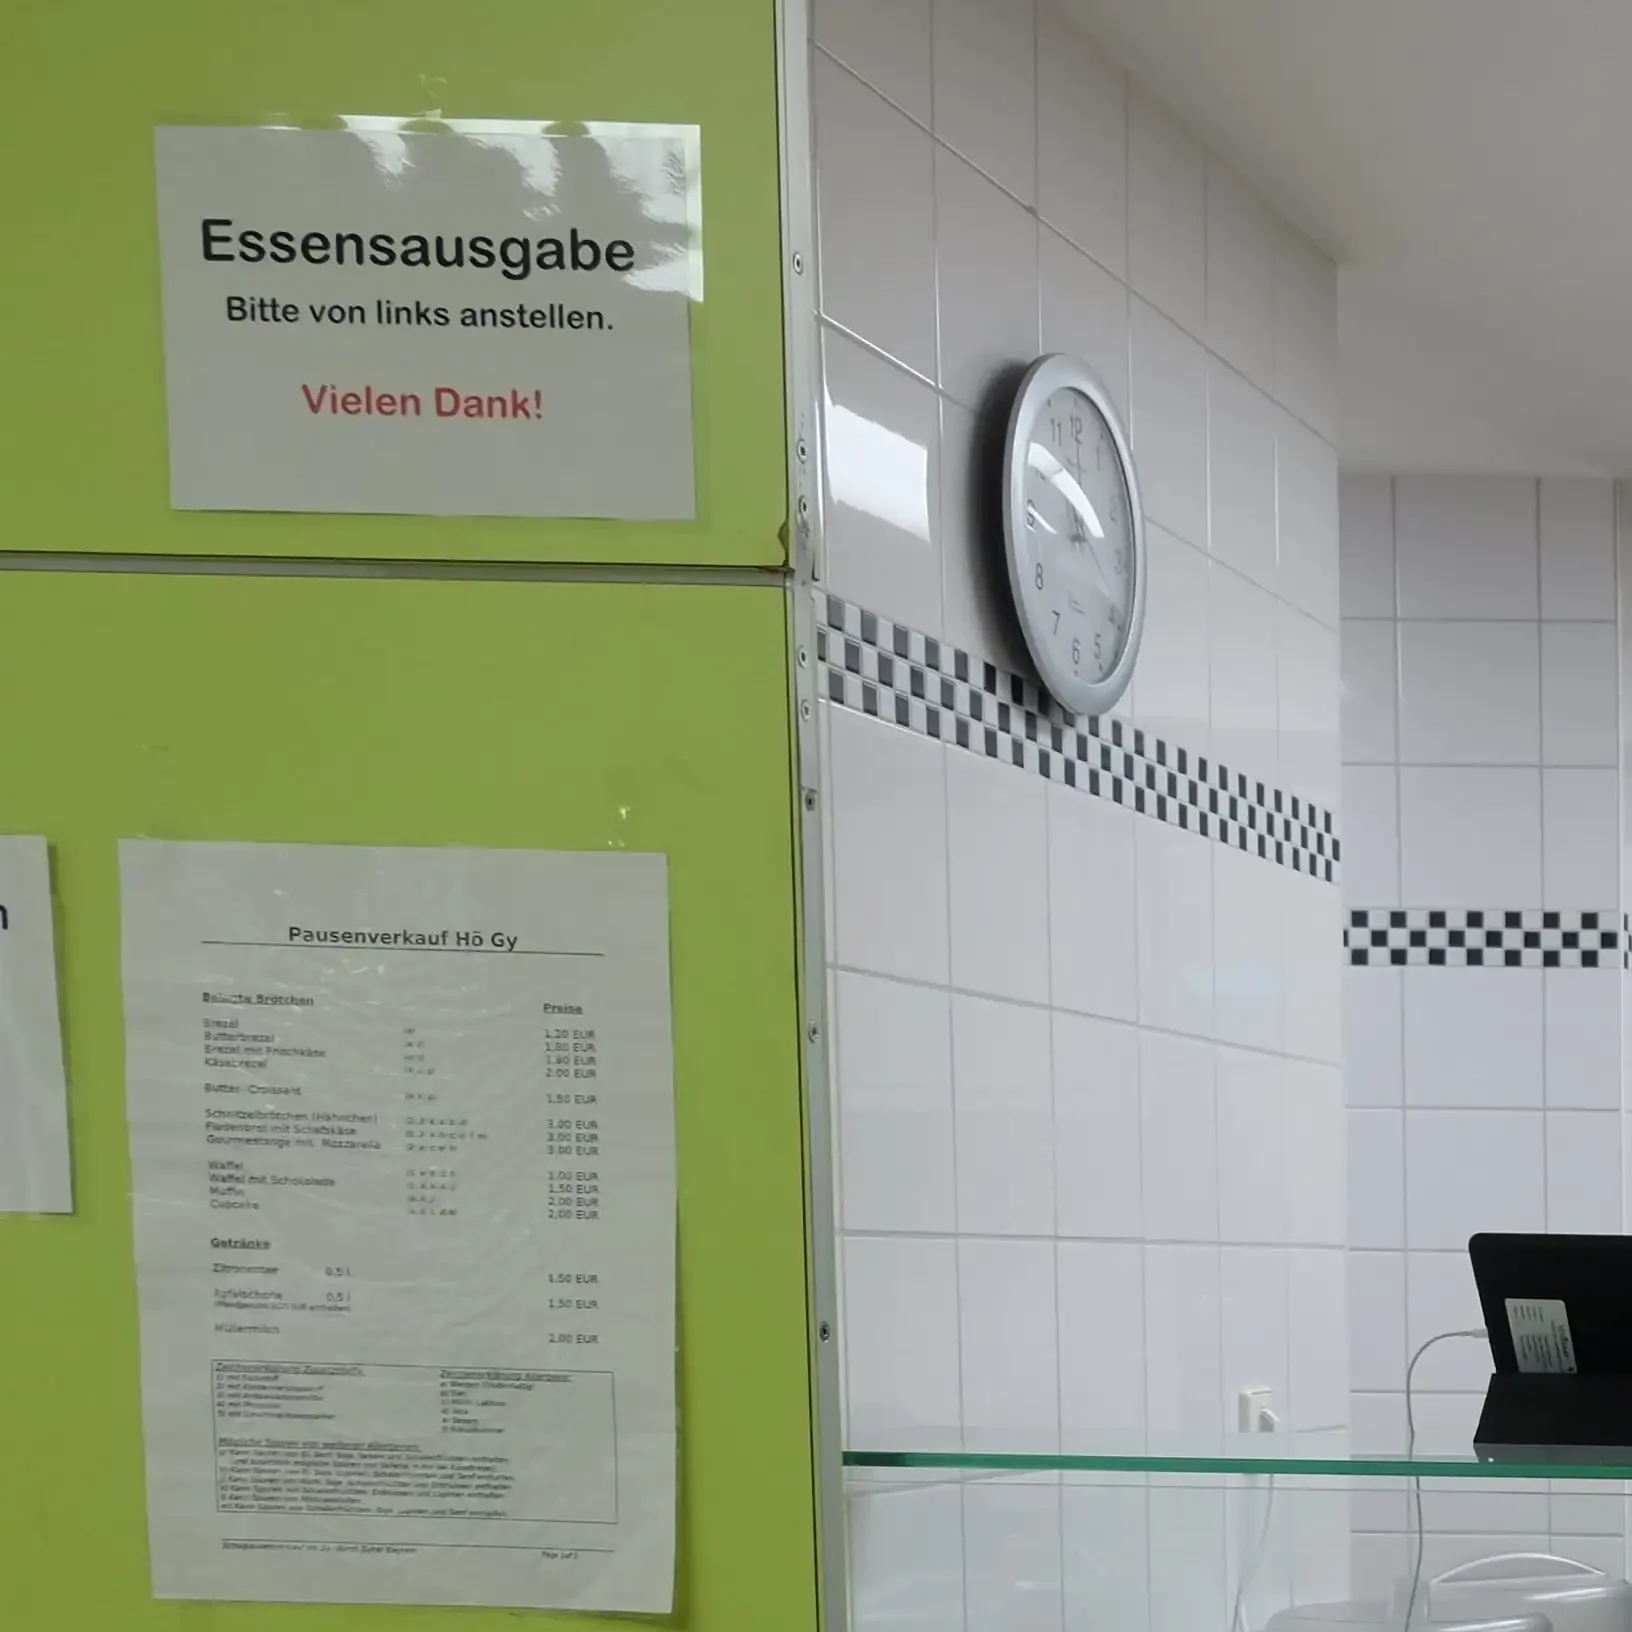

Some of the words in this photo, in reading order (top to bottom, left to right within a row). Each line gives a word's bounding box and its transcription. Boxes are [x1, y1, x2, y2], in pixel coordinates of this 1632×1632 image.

[202, 218, 636, 281] Essensausgabe
[226, 296, 300, 323] Bitte
[309, 304, 366, 325] von
[376, 300, 450, 327] links
[460, 303, 615, 331] anstellen.
[301, 383, 421, 417] Vielen
[433, 386, 545, 420] Dank!
[1034, 561, 1044, 591] 8
[1051, 608, 1061, 637] 7
[1071, 637, 1081, 666] 6
[288, 926, 449, 946] Pausenverkauf
[490, 931, 519, 952] Gy
[543, 1002, 584, 1016] Preise
[573, 1030, 597, 1041] EUR
[573, 1043, 598, 1054] EUR
[573, 1056, 597, 1067] EUR
[573, 1069, 597, 1080] EUR
[574, 1094, 598, 1106] EUR
[575, 1119, 599, 1131] EUR
[575, 1132, 600, 1144] EUR
[575, 1145, 600, 1157] EUR
[575, 1170, 600, 1183] EUR
[575, 1184, 600, 1195] EUR
[575, 1196, 600, 1208] EUR
[575, 1209, 600, 1221] EUR
[210, 1238, 272, 1251] Getränke
[575, 1274, 600, 1285] EUR
[575, 1299, 600, 1310] EUR
[575, 1333, 600, 1345] EUR
